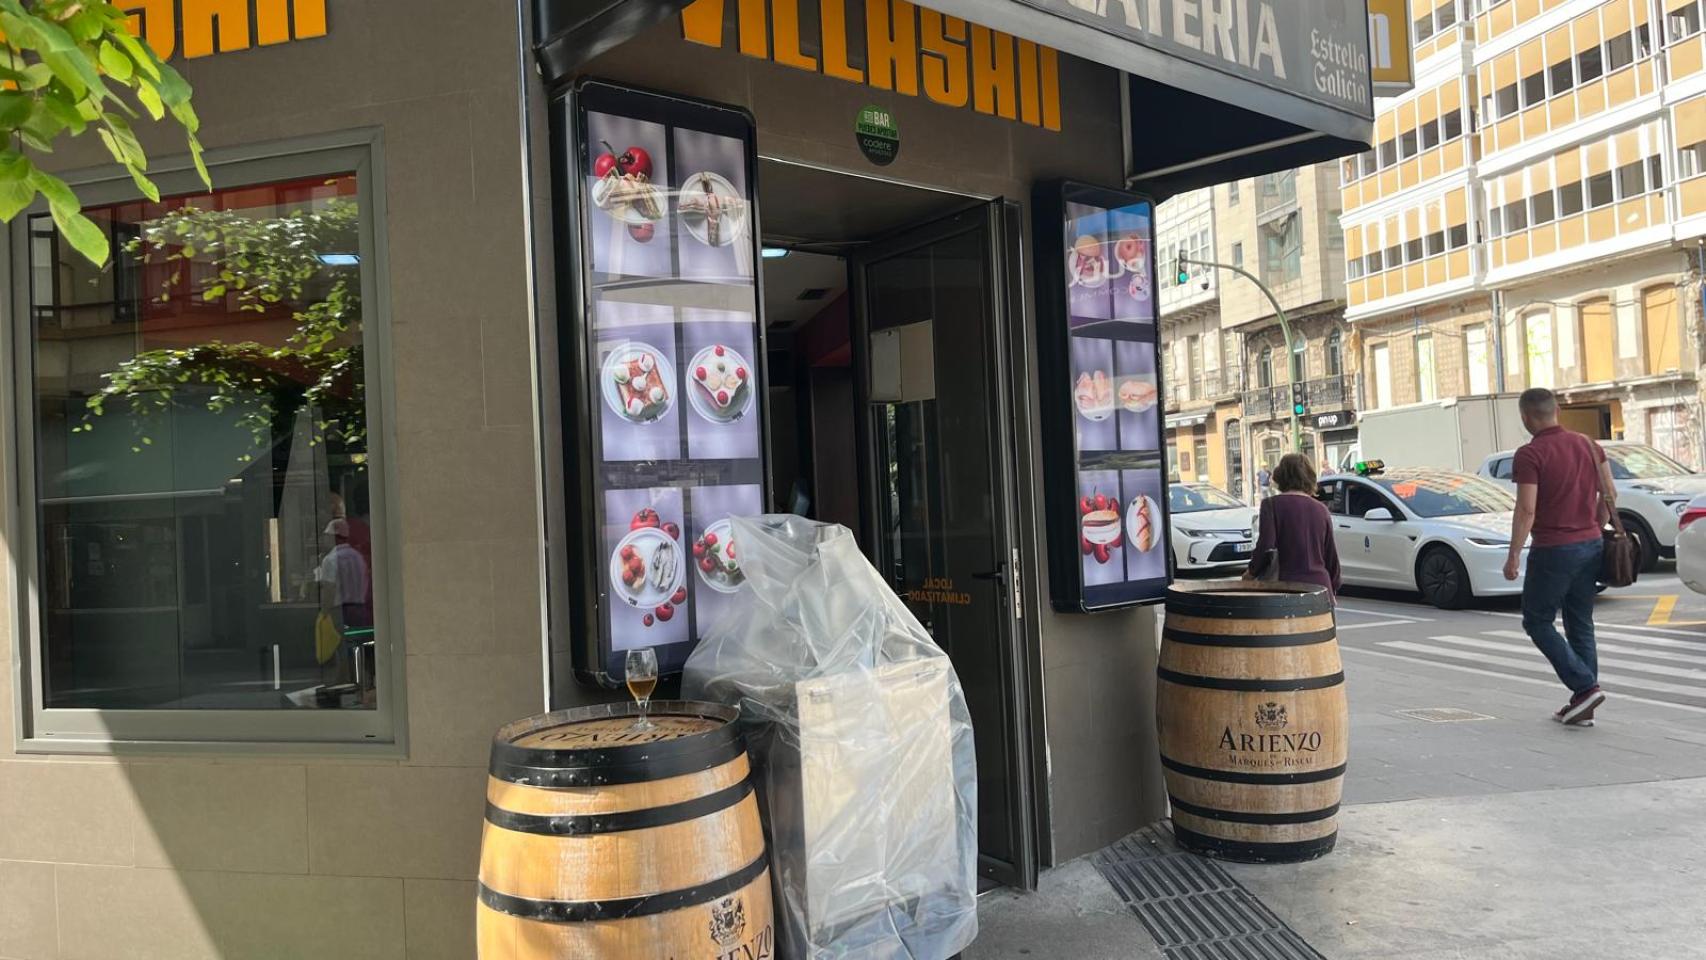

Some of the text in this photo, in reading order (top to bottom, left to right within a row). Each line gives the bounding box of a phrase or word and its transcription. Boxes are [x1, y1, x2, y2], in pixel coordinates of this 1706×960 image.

[1065, 0, 1288, 80] ERIA
[1310, 28, 1367, 74] Estrella
[1314, 61, 1367, 105] Galicia
[874, 111, 889, 128] BAR
[1220, 726, 1321, 752] ARIENZO
